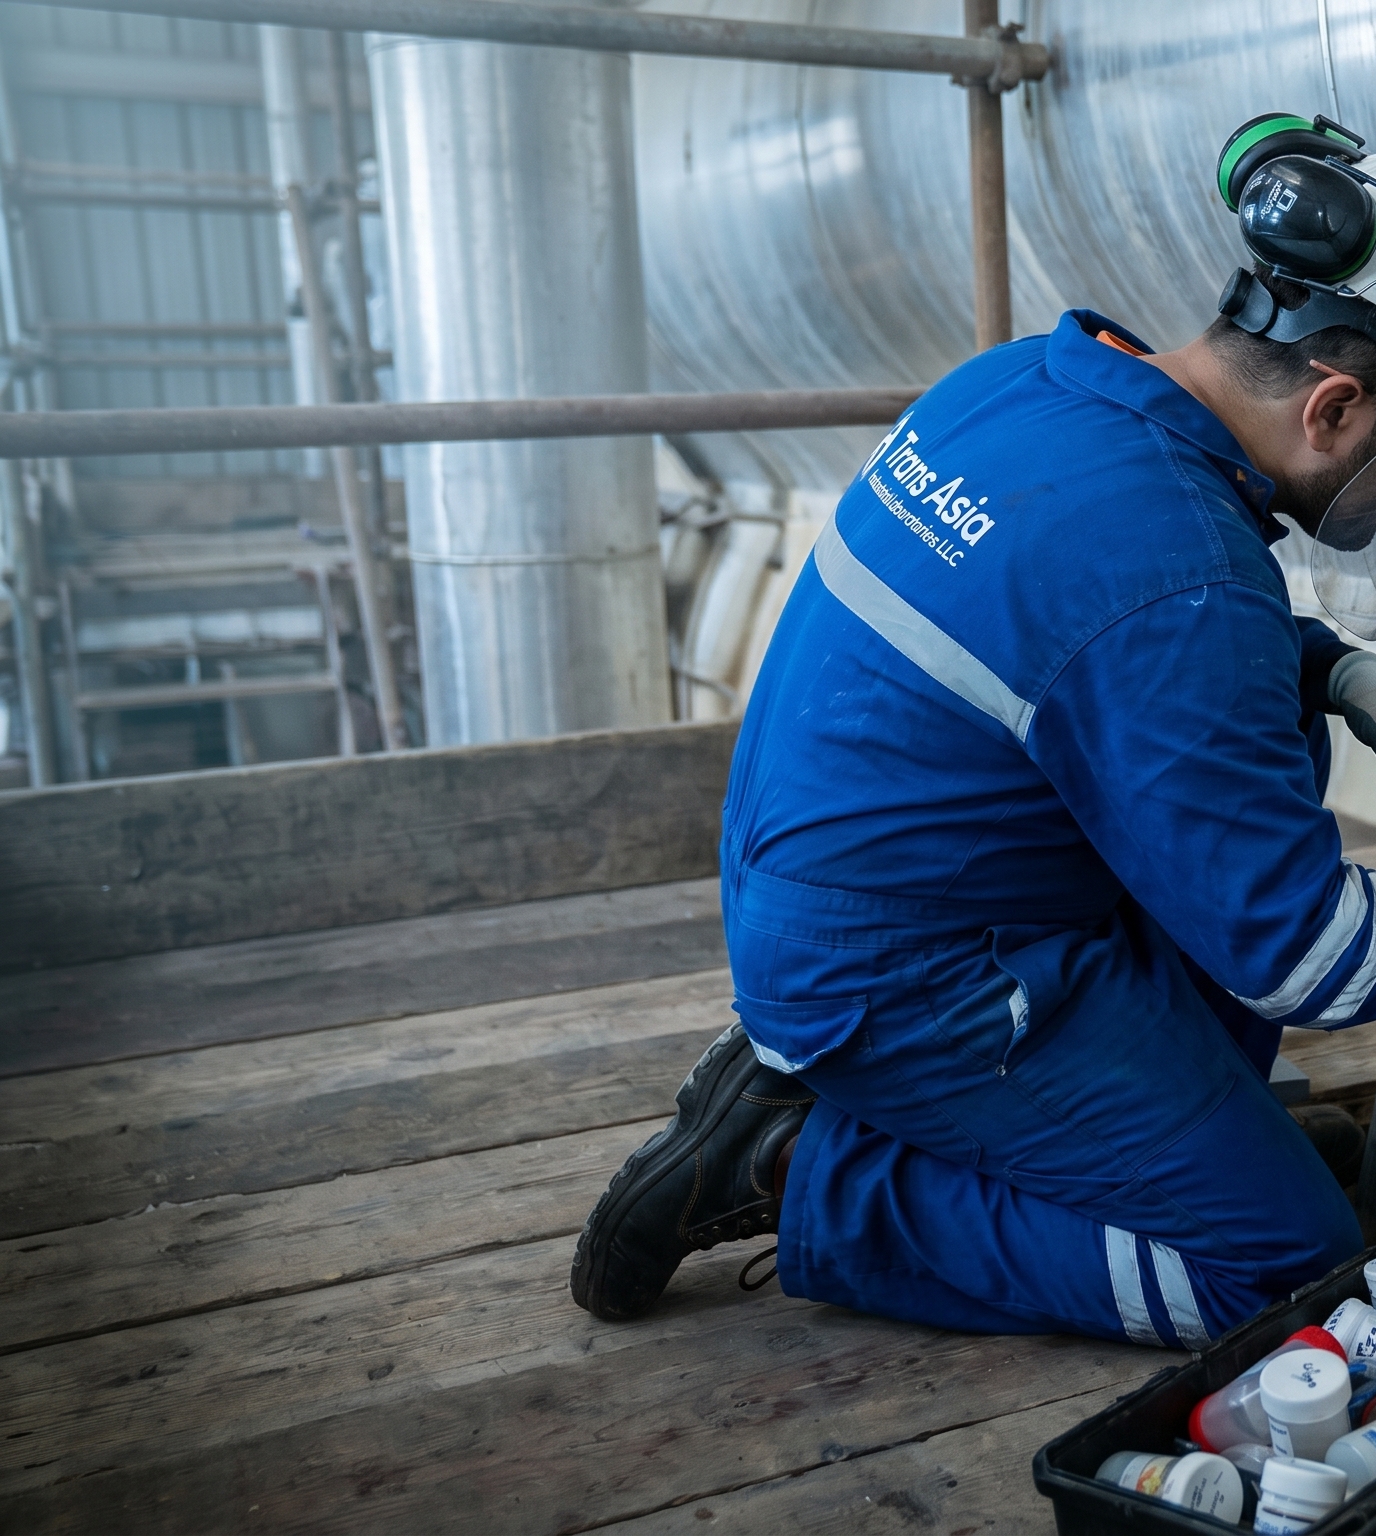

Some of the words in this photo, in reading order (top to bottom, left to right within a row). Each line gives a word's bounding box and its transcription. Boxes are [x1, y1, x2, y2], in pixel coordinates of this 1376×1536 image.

[885, 430, 937, 497] Trans
[920, 476, 996, 547] Asia
[935, 539, 964, 567] LLC
